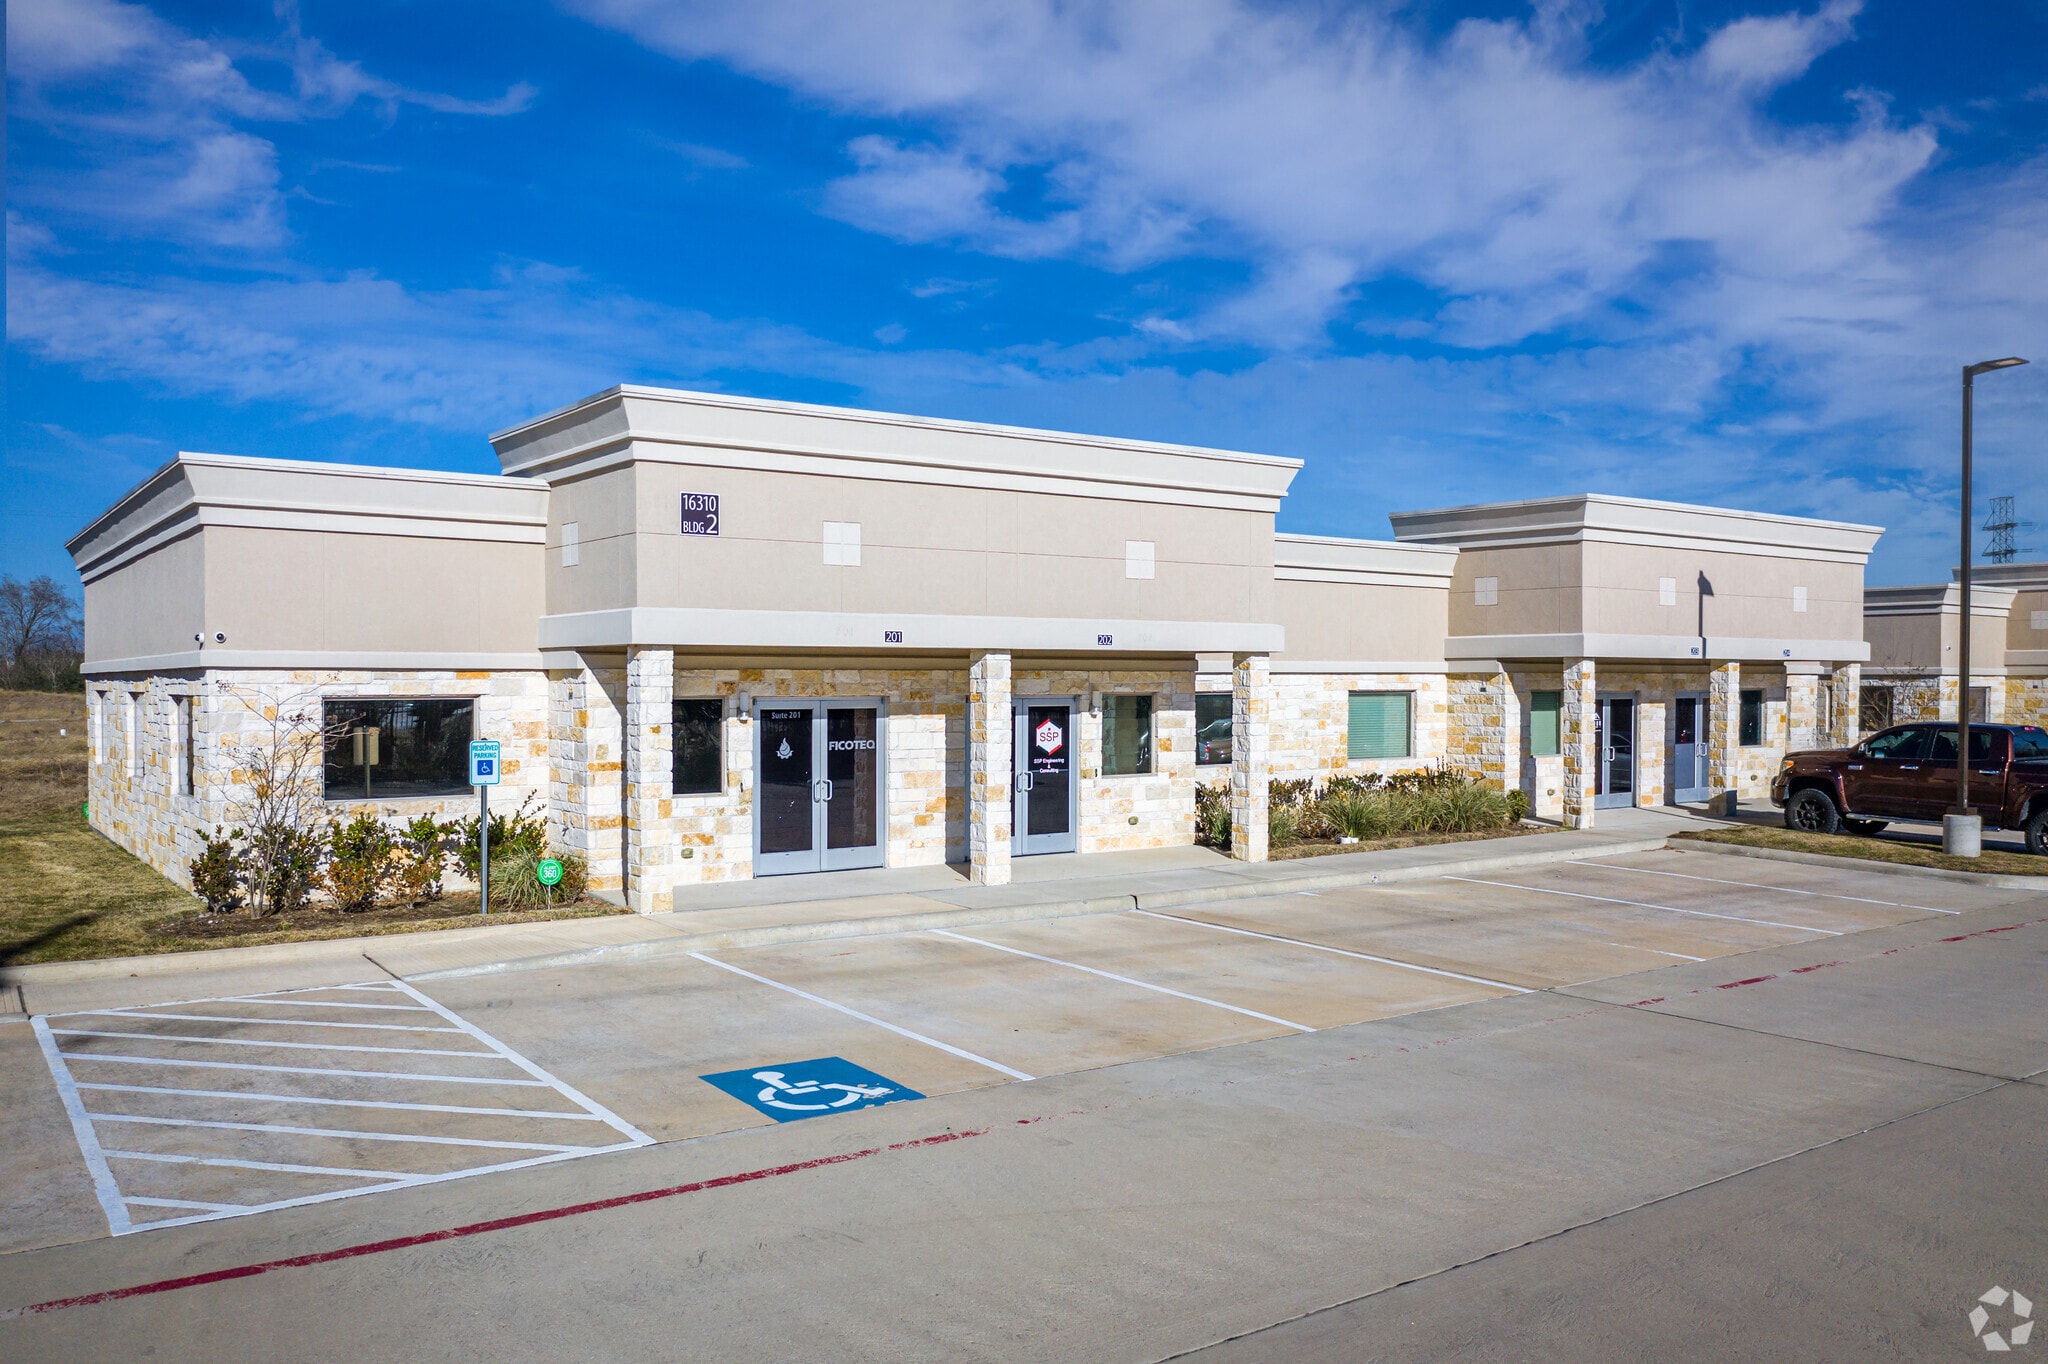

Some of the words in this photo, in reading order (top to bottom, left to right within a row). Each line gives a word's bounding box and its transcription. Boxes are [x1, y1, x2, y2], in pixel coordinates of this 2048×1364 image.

[682, 494, 717, 512] 16310
[683, 521, 705, 533] BLDG
[706, 514, 718, 534] 2
[886, 631, 902, 642] 201
[1098, 635, 1112, 645] 202
[771, 711, 788, 719] Suite
[789, 711, 801, 719] 201
[1040, 732, 1059, 742] SSP
[829, 740, 876, 751] FICOTEQ
[543, 870, 557, 878] 360
